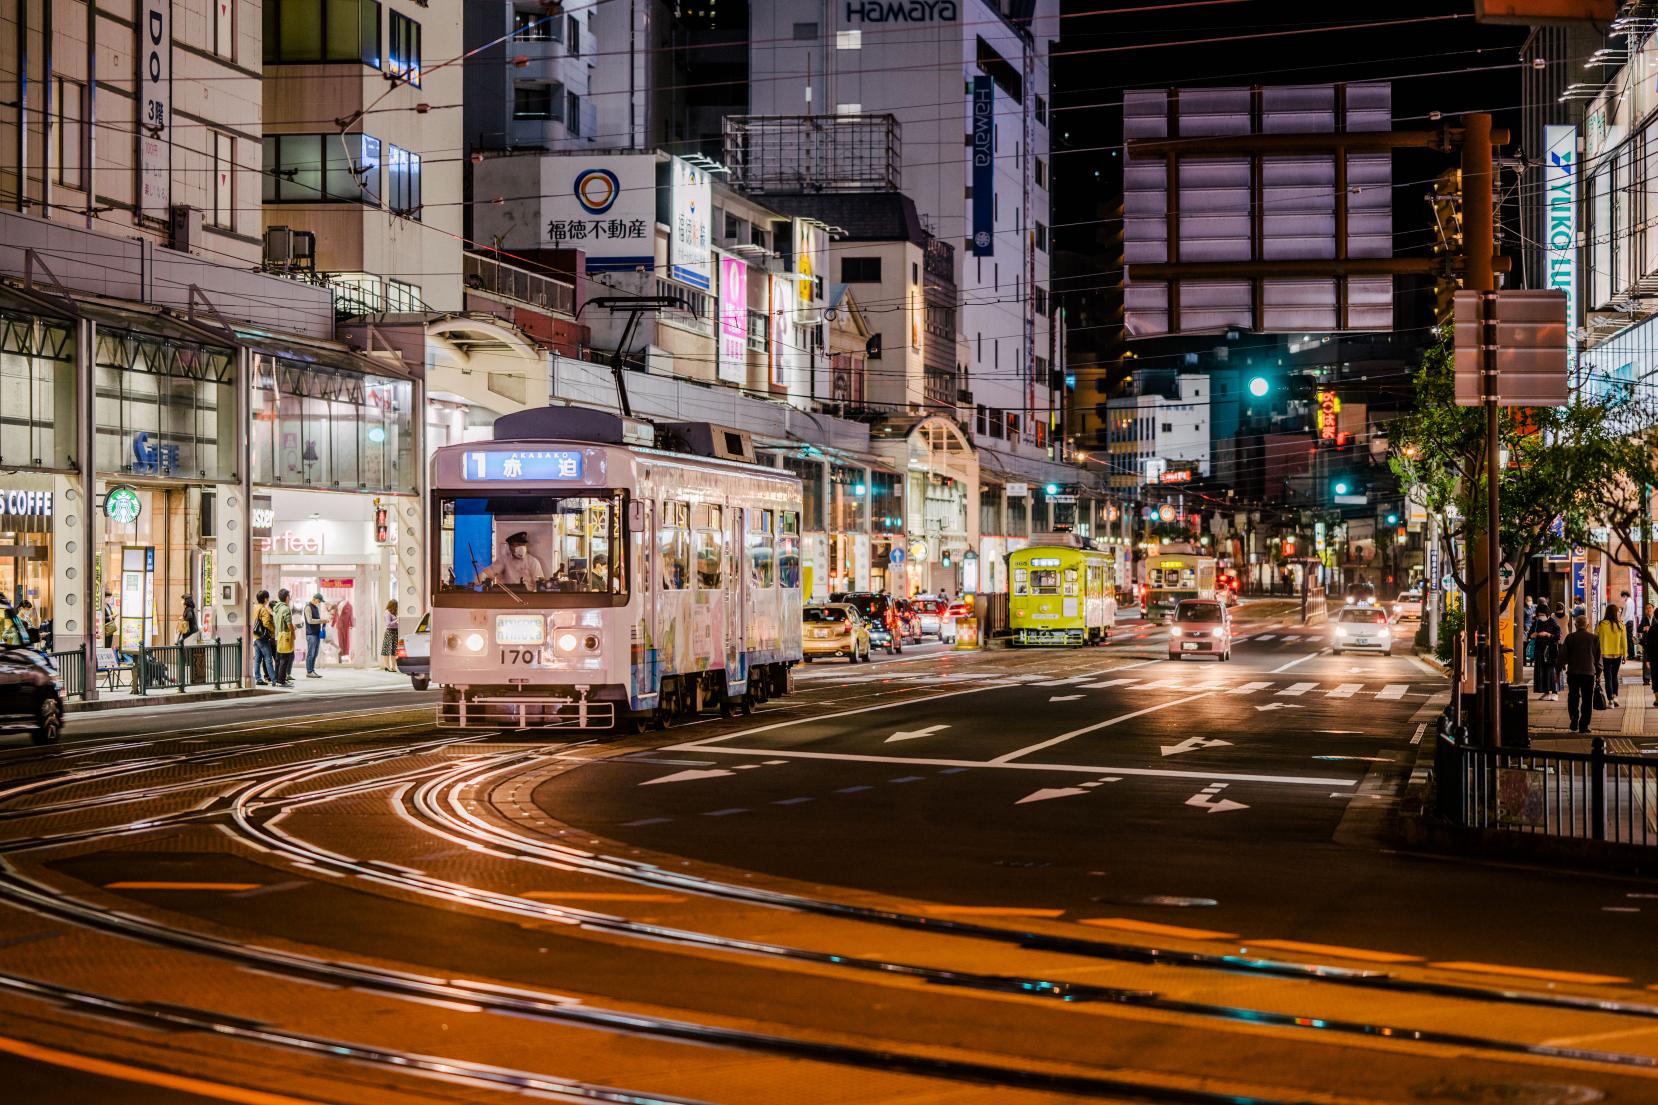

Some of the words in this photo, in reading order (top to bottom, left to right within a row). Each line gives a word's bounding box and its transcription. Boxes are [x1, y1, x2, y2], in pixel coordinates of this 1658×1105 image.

[149, 0, 163, 83] DO
[1551, 181, 1571, 250] YUKO
[547, 218, 647, 240] 福徳不動産
[472, 453, 485, 477] 1
[503, 458, 577, 477] 赤迫
[501, 650, 541, 664] 1701
